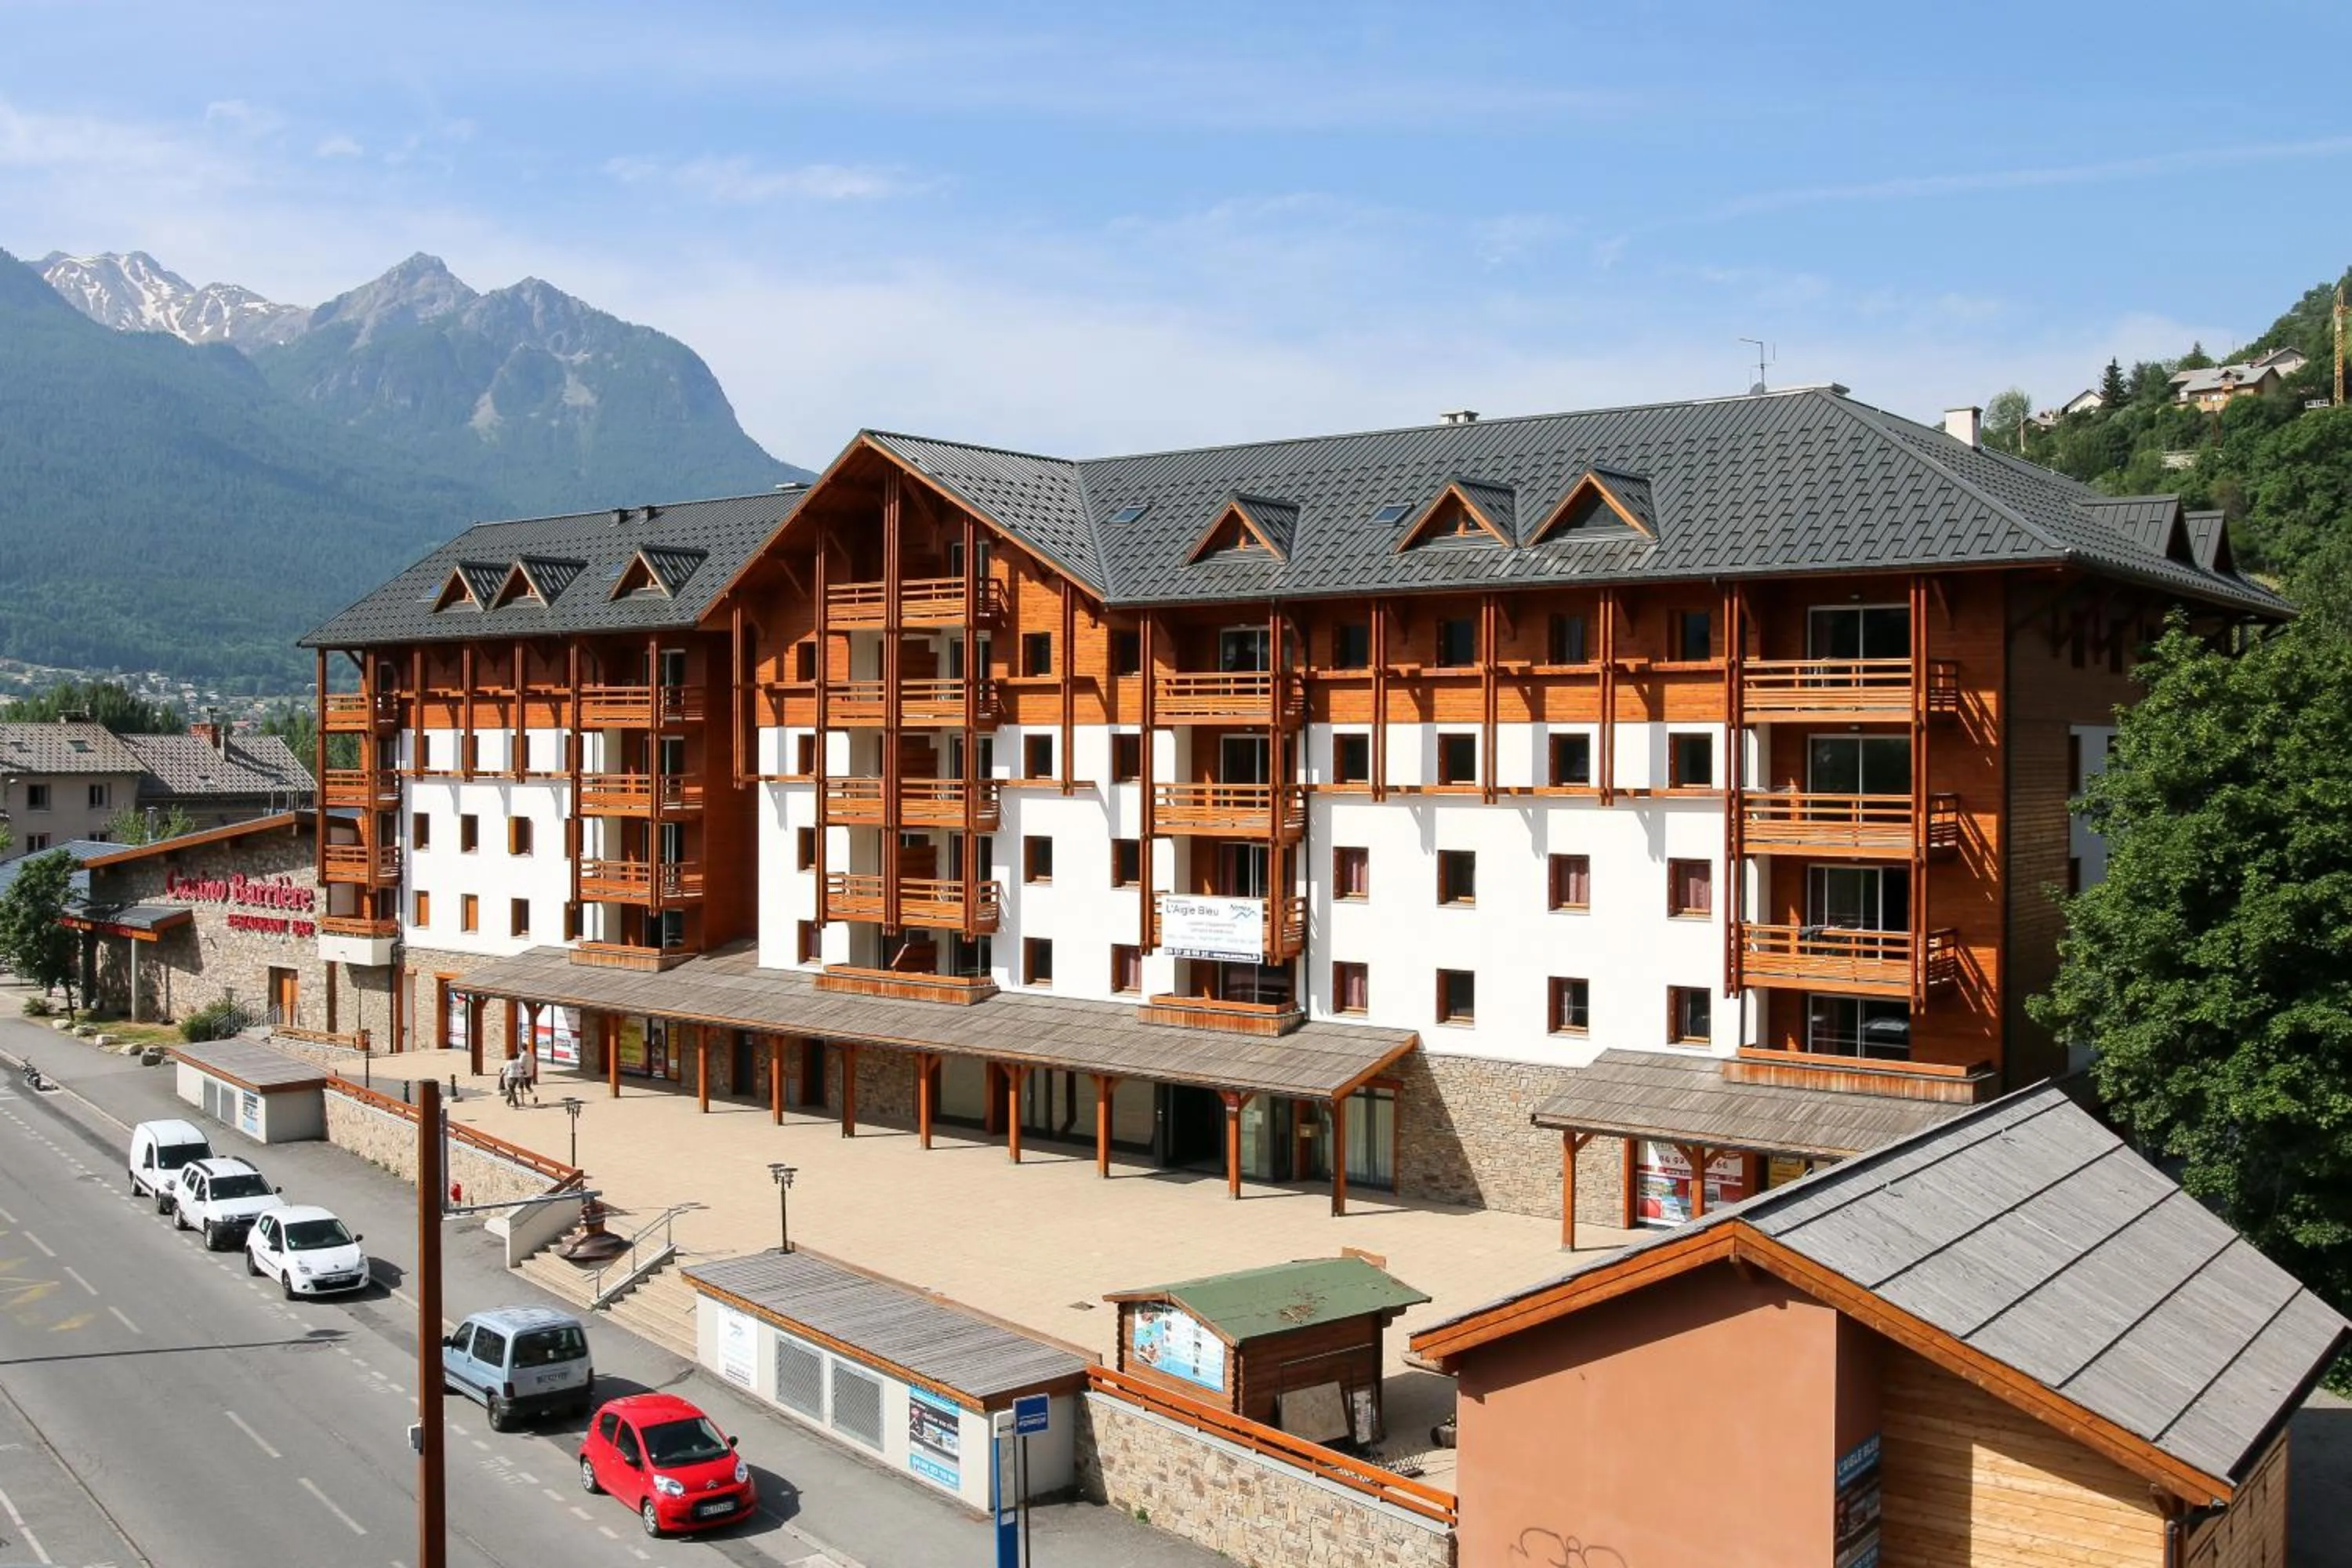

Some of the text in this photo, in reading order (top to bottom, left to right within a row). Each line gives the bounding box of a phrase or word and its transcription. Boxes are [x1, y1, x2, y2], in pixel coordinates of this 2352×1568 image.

[166, 869, 314, 910] Casino Barrière
[1166, 904, 1219, 916] L'Aigle Bleu
